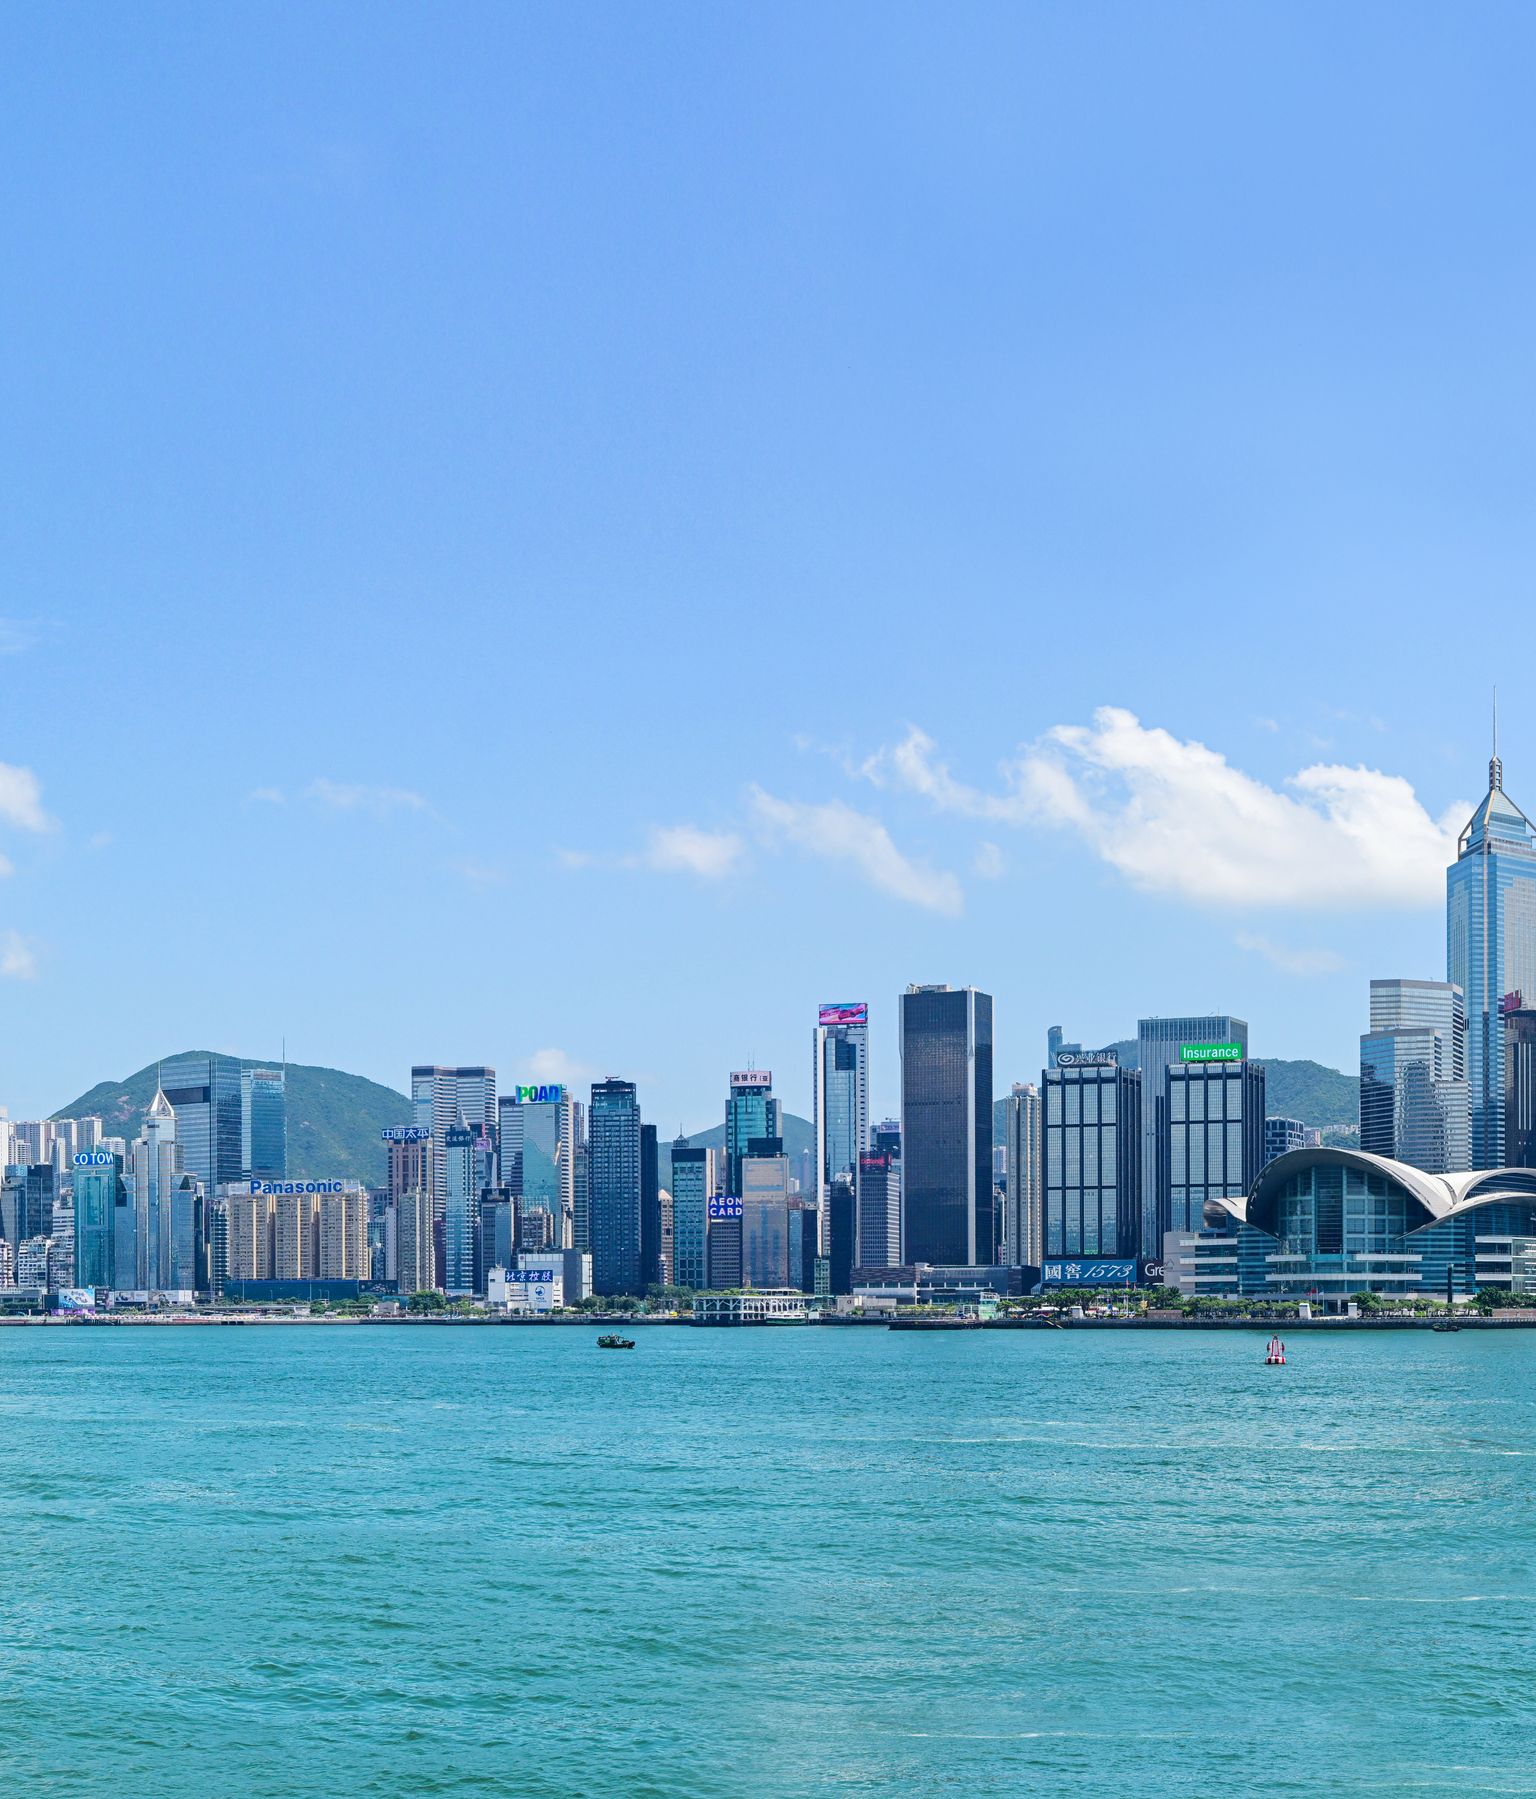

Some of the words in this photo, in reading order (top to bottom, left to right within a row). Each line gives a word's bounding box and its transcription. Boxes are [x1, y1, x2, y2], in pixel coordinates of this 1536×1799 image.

[1183, 1047, 1239, 1059] Insurance
[518, 1086, 559, 1102] POAD
[382, 1129, 429, 1140] 中国太平
[250, 1178, 342, 1194] Panasonic
[710, 1197, 743, 1206] AEON
[710, 1207, 743, 1216] CARD
[1144, 1263, 1165, 1277] Gre
